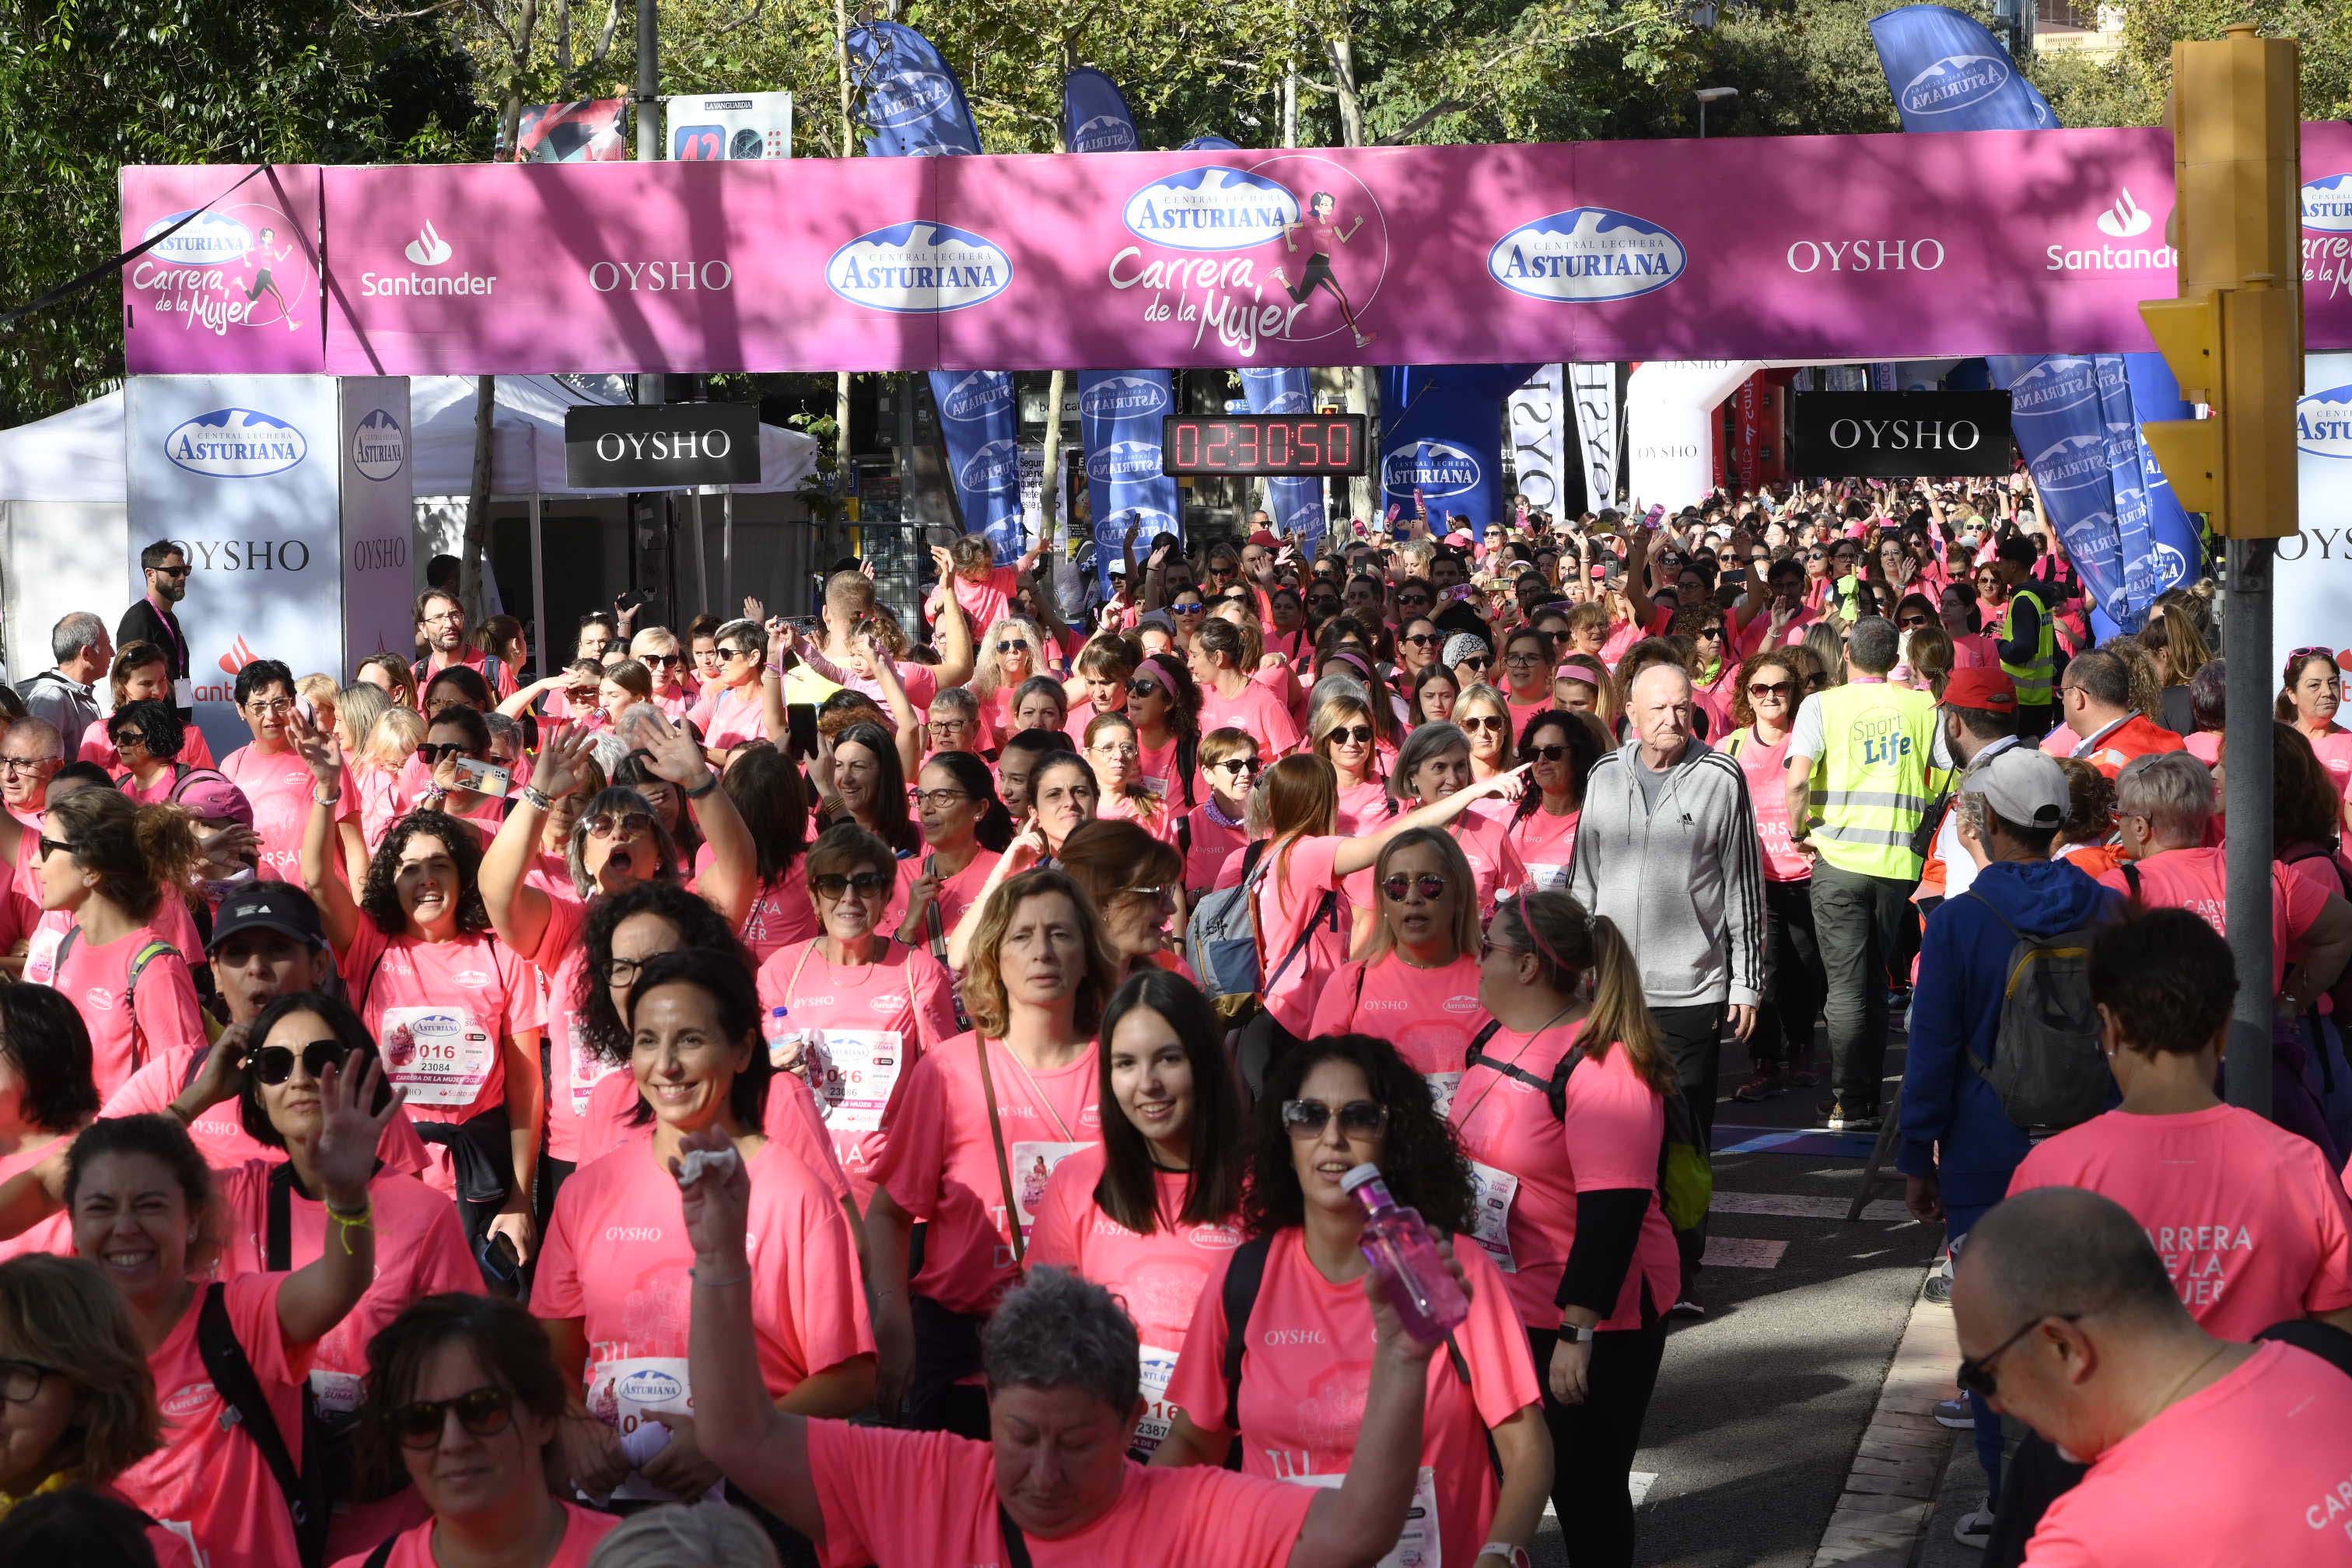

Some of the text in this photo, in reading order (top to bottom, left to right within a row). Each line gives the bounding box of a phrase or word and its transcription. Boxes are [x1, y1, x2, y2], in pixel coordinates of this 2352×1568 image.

[1137, 199, 1286, 229] ASTURIANA
[870, 253, 928, 261] CENTRAL
[1534, 239, 1664, 250] CENTRAL LECHERA
[1787, 238, 1944, 273] OYSHO
[841, 256, 998, 289] ASTURIANA
[1109, 247, 1254, 289] Carrera
[1504, 245, 1671, 278] ASTURIANA
[2319, 260, 2332, 282] la
[133, 261, 224, 290] Carrera
[362, 272, 496, 296] Santander
[589, 260, 731, 292] OYSHO
[156, 289, 258, 335] de la Mujer
[1144, 286, 1308, 357] de la Mujer
[597, 429, 730, 461] OYSHO
[1177, 424, 1349, 466] 02:30:50
[1830, 418, 1979, 450] OYSHO
[176, 435, 297, 460] ASTURIANA
[356, 437, 402, 464] ASTURIANA
[1639, 444, 1697, 458] OYSHO
[1386, 465, 1472, 485] ASTURIANA
[355, 537, 405, 571] OYSHO
[1853, 713, 1904, 741] Sport
[1864, 732, 1911, 766] Life
[1364, 1000, 1408, 1010] OYSHO
[417, 1023, 457, 1033] ASTURIANA
[419, 1045, 455, 1059] 016
[421, 1062, 450, 1072] 23084
[826, 1069, 863, 1083] 016
[606, 1227, 661, 1241] OYSHO
[2189, 1253, 2224, 1278] LA
[623, 1383, 677, 1395] ASTURIANA
[1137, 1422, 1169, 1437] 2387
